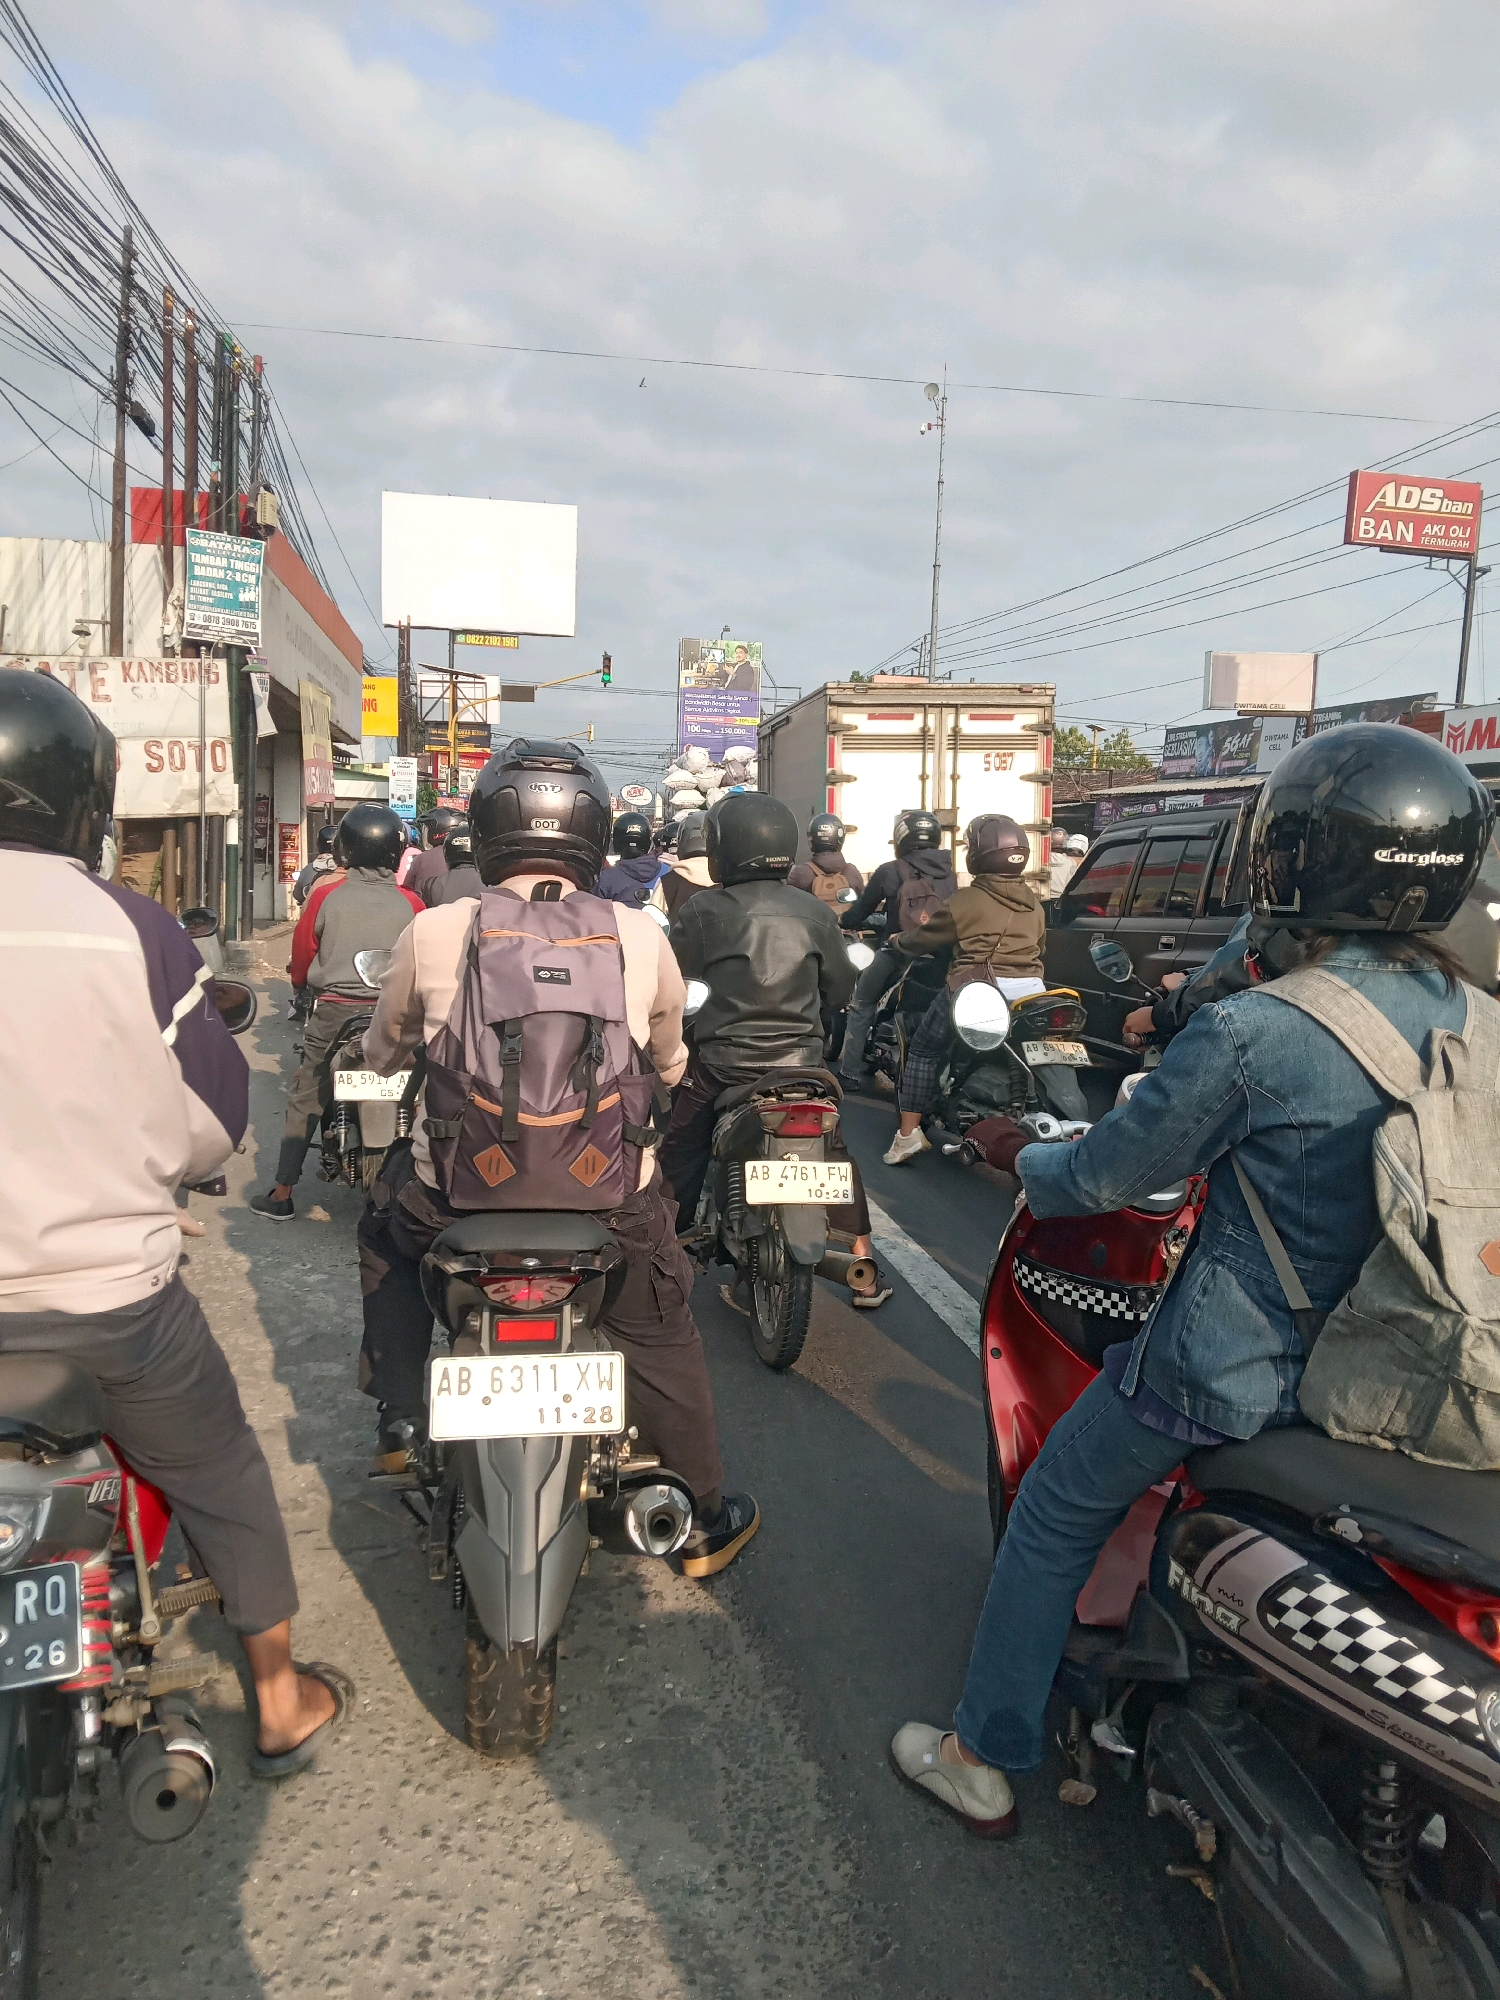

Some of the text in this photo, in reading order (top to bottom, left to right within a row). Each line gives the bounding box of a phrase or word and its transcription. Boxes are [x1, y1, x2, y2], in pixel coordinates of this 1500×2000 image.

[1358, 516, 1471, 543] BAN AKI OLI
[199, 538, 251, 554] BATARA
[1420, 536, 1470, 549] TERMURAH
[189, 552, 260, 574] TAMBAH TINGGI
[194, 565, 225, 579] BADAN
[202, 614, 257, 630] 0878 3908 7675
[466, 634, 518, 648] 0822 2102 1981
[122, 661, 220, 684] KAMBING
[687, 725, 700, 733] 100
[1264, 732, 1289, 742] DWITAMA
[1268, 743, 1282, 751] CELL
[144, 740, 227, 773] SOTO
[535, 820, 556, 829] DOT
[1374, 847, 1465, 866] Cargloss
[1026, 1043, 1039, 1053] AB
[338, 1073, 353, 1085] AB
[750, 1165, 848, 1182] AB 4761 FW
[437, 1361, 614, 1396] AB 6311 XW
[15, 1574, 66, 1626] RO
[1217, 1587, 1244, 1607] mio
